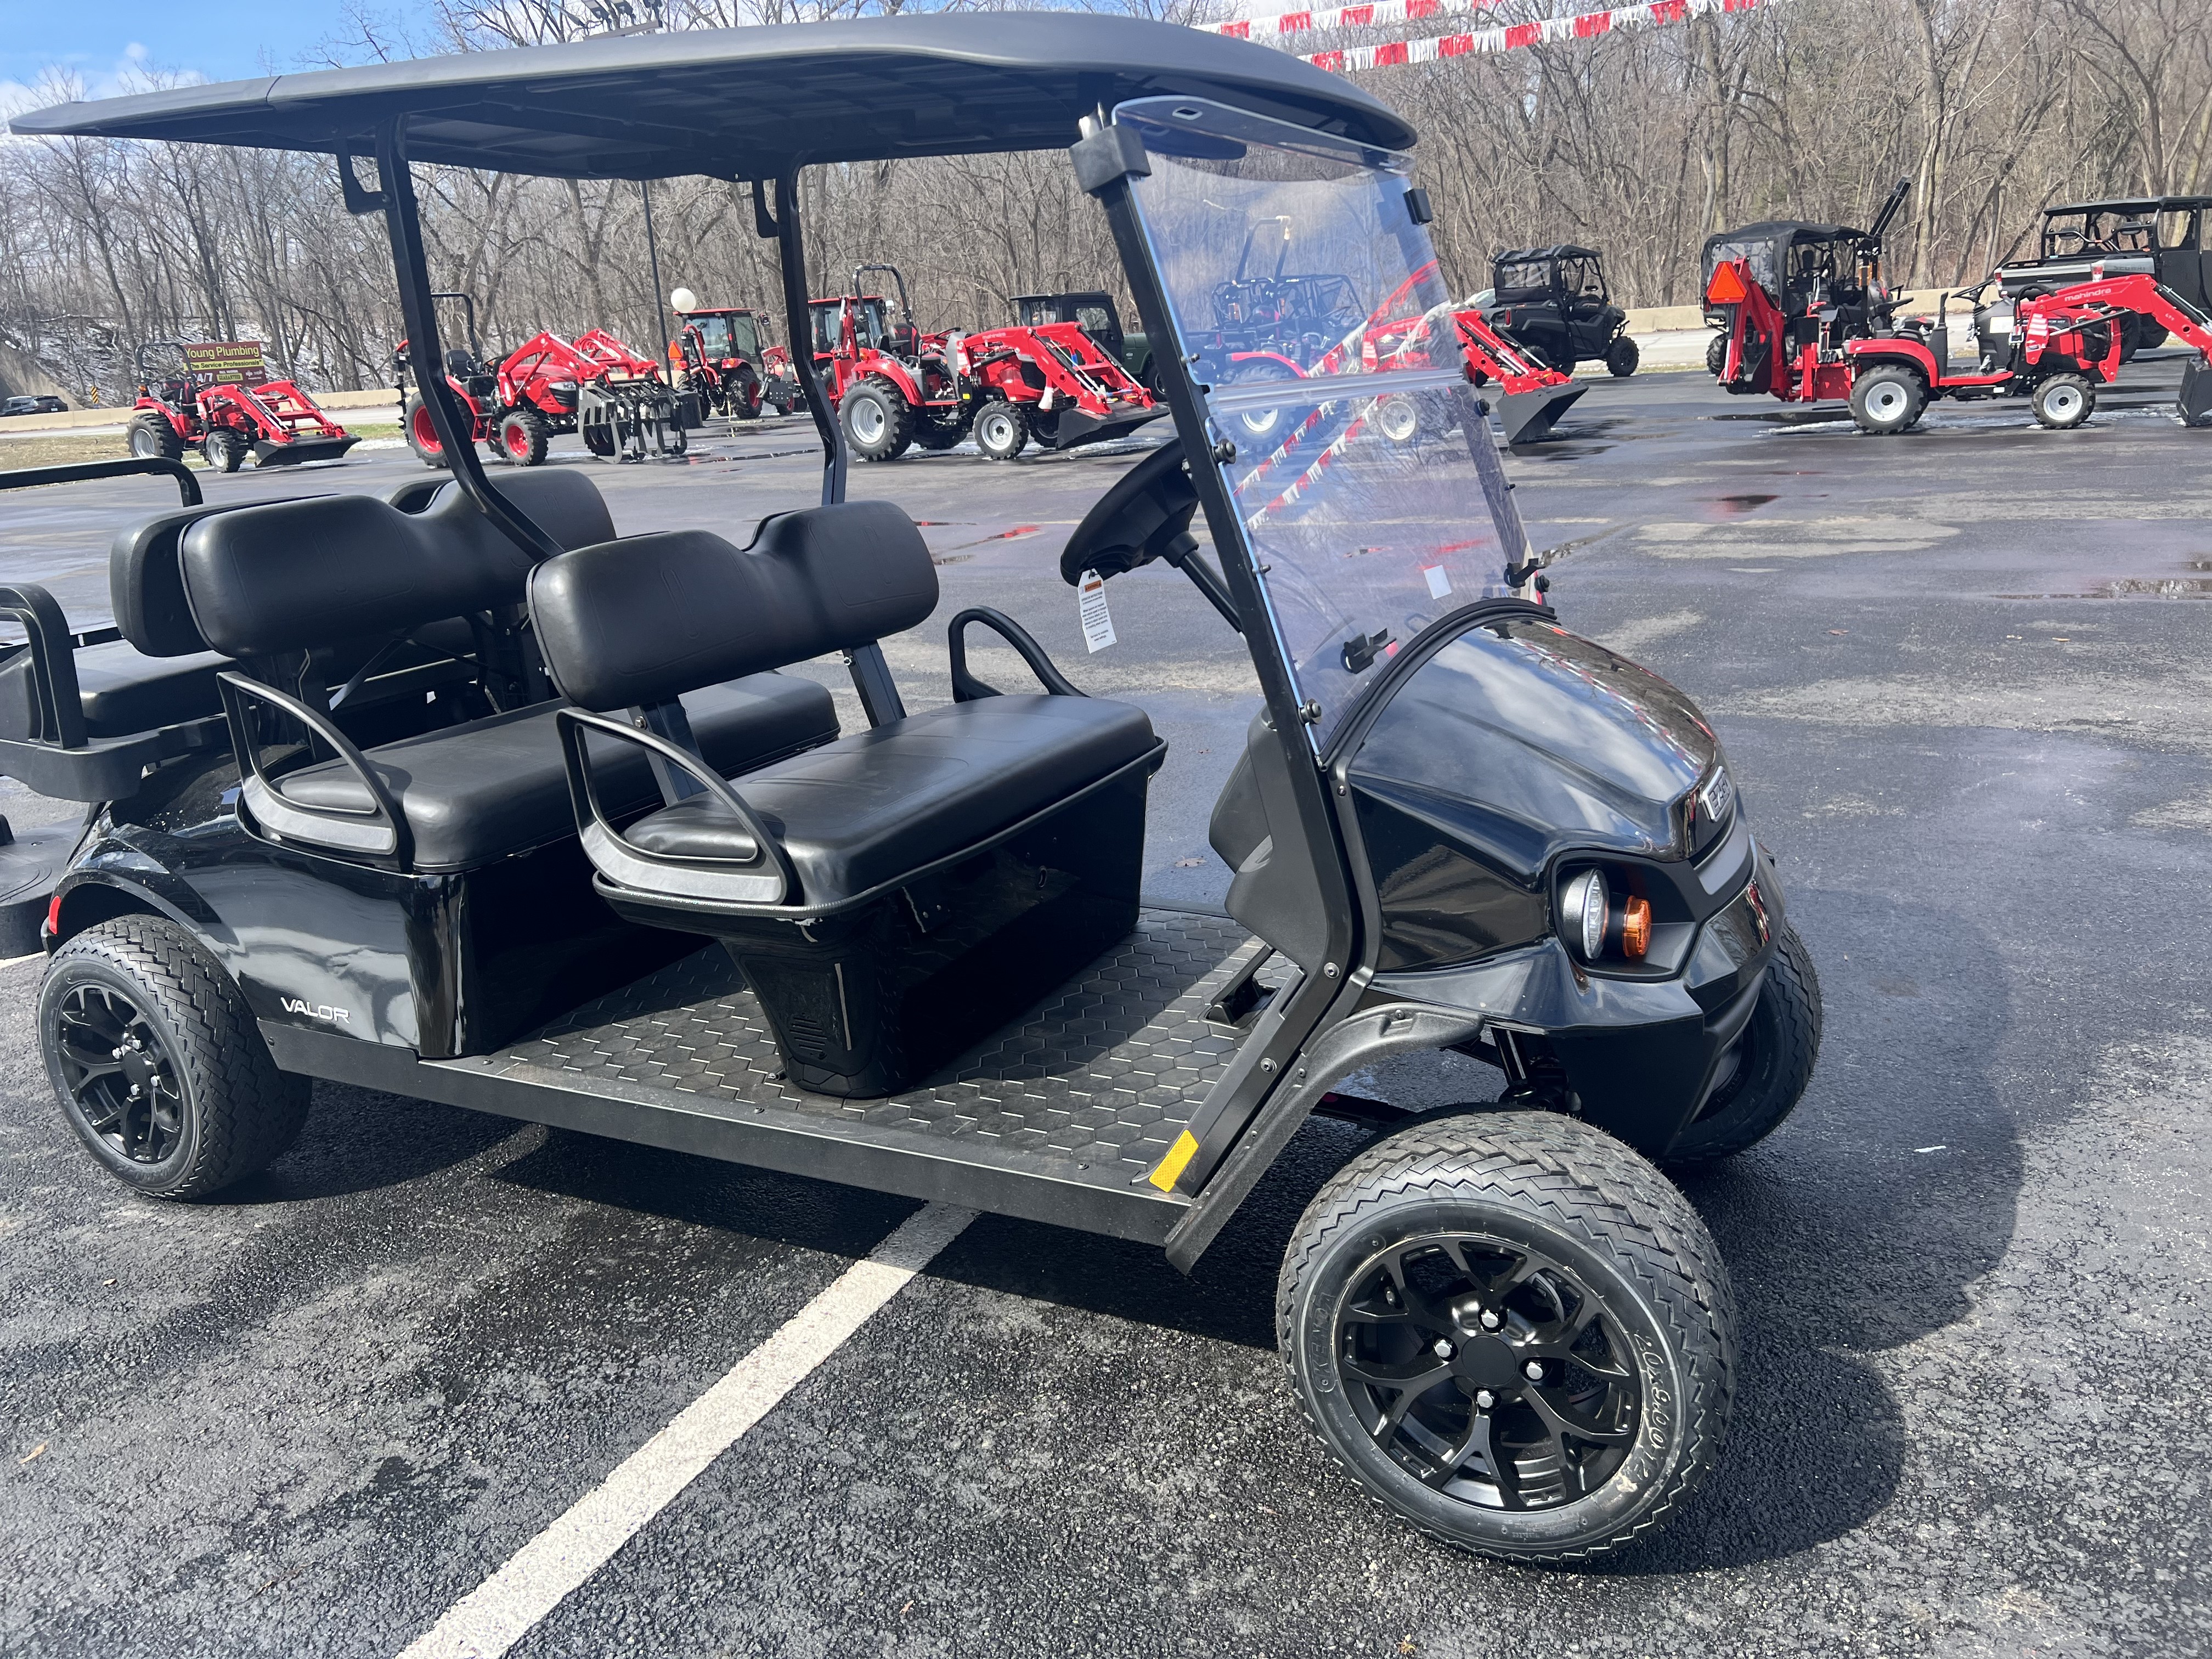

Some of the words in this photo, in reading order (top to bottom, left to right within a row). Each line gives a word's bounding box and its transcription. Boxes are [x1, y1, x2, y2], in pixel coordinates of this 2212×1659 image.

[2064, 288, 2112, 302] mahindra
[185, 348, 215, 360] Young
[216, 345, 260, 357] Plumbing
[280, 997, 350, 1024] VALOR
